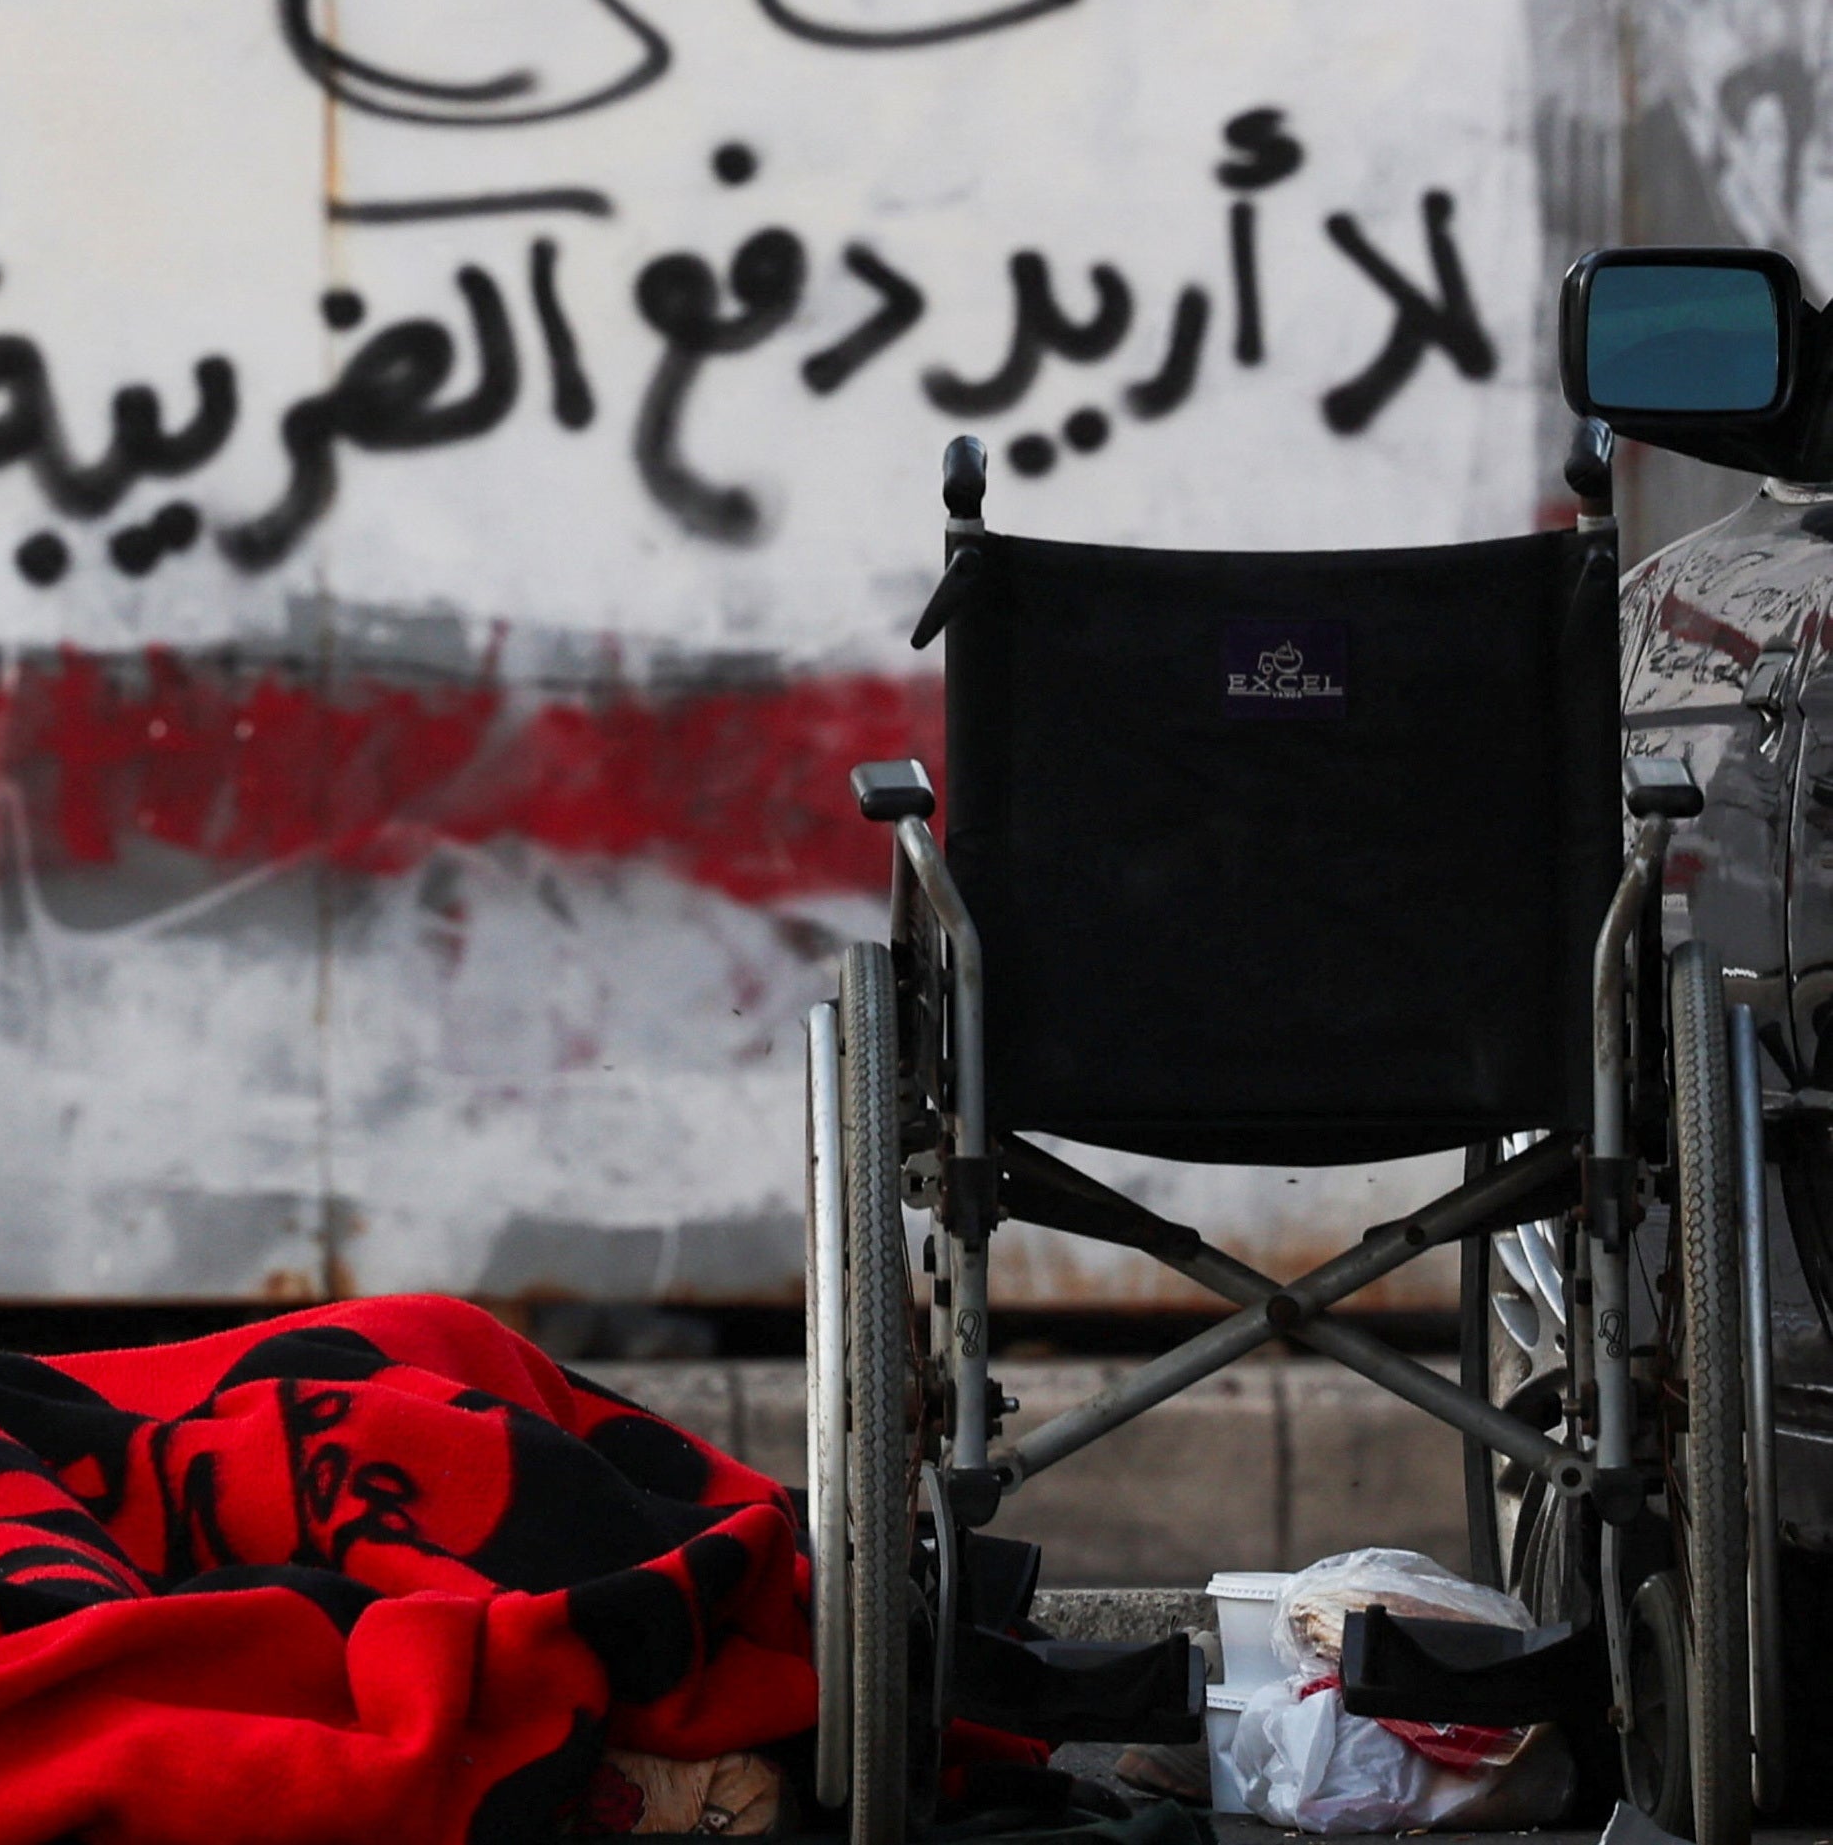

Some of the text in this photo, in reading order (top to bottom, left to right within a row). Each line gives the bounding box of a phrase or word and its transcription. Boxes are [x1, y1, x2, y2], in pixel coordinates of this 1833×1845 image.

[633, 140, 925, 546] دفع
[923, 106, 1311, 478] أريد
[1227, 673, 1343, 695] EXCEL
